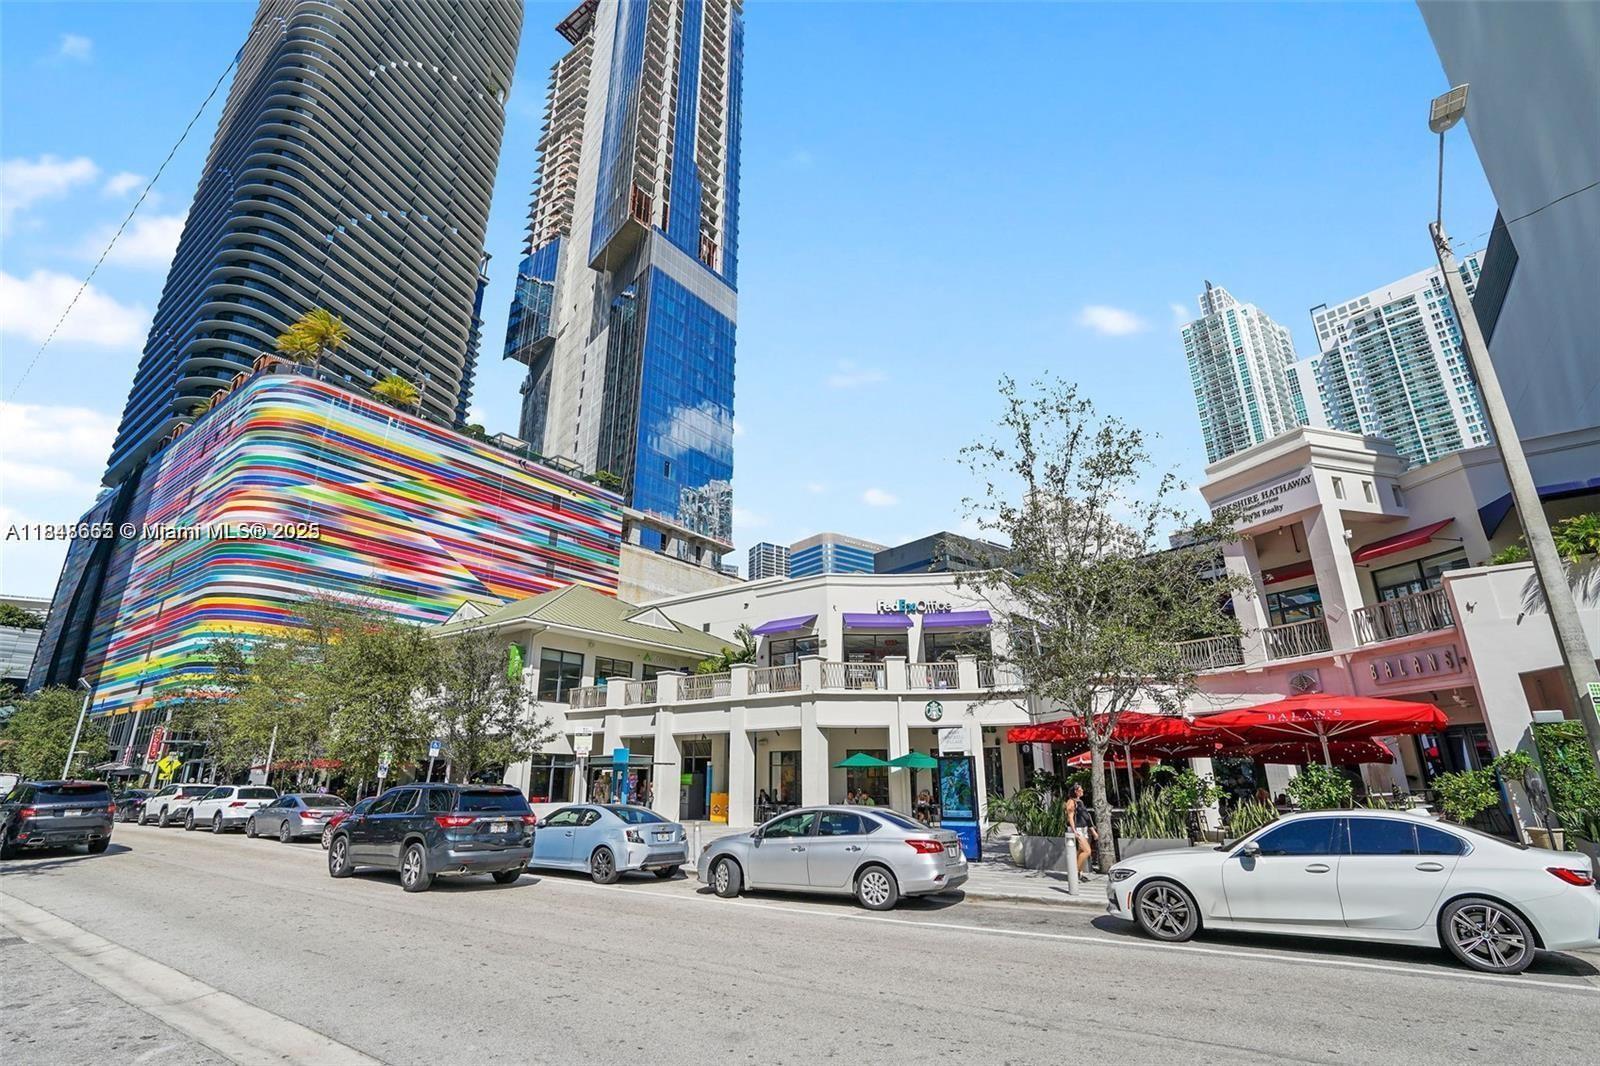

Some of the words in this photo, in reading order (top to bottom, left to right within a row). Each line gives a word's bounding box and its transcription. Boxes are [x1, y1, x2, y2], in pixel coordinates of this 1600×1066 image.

[1261, 474, 1312, 500] HATHAWAY
[1261, 504, 1284, 517] Realty
[1370, 650, 1455, 680] BALANS
